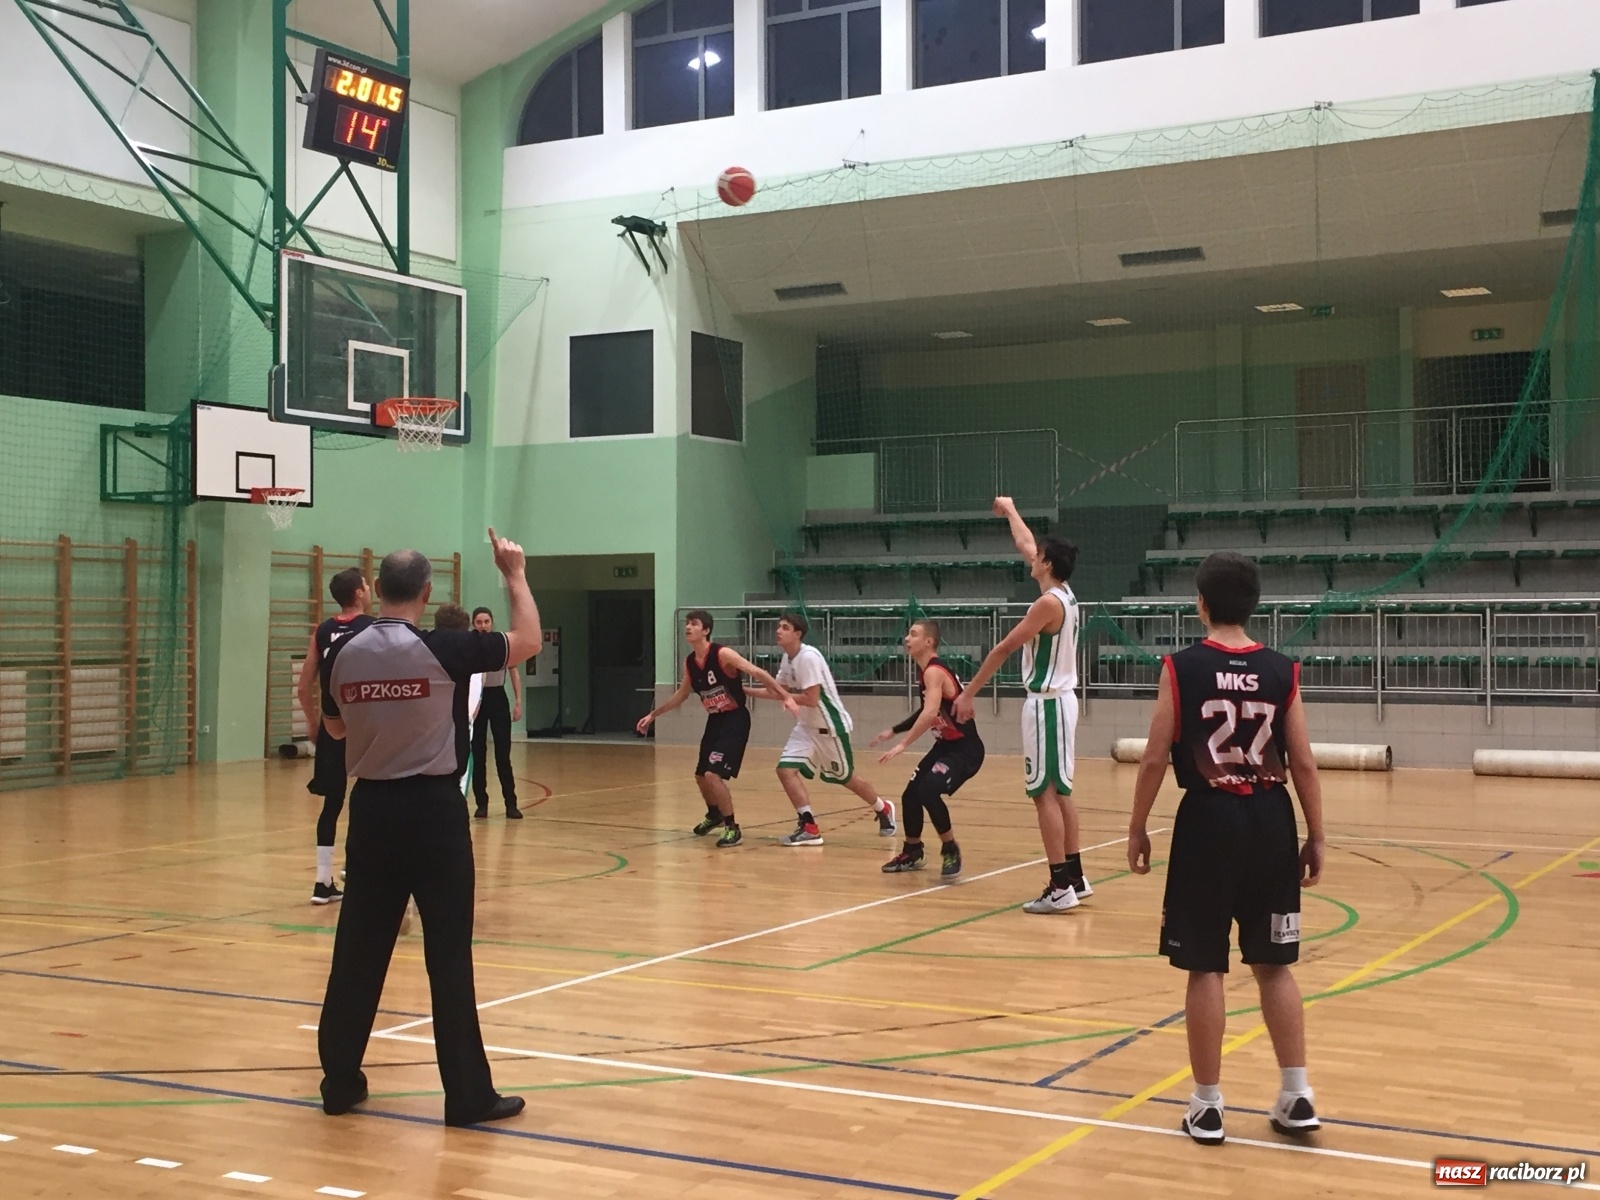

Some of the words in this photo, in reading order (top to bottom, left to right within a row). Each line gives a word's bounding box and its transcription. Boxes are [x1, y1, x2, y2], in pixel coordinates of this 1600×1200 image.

[346, 111, 381, 150] 14
[707, 670, 717, 685] 8
[1216, 672, 1259, 692] MKS
[1201, 699, 1277, 766] 27
